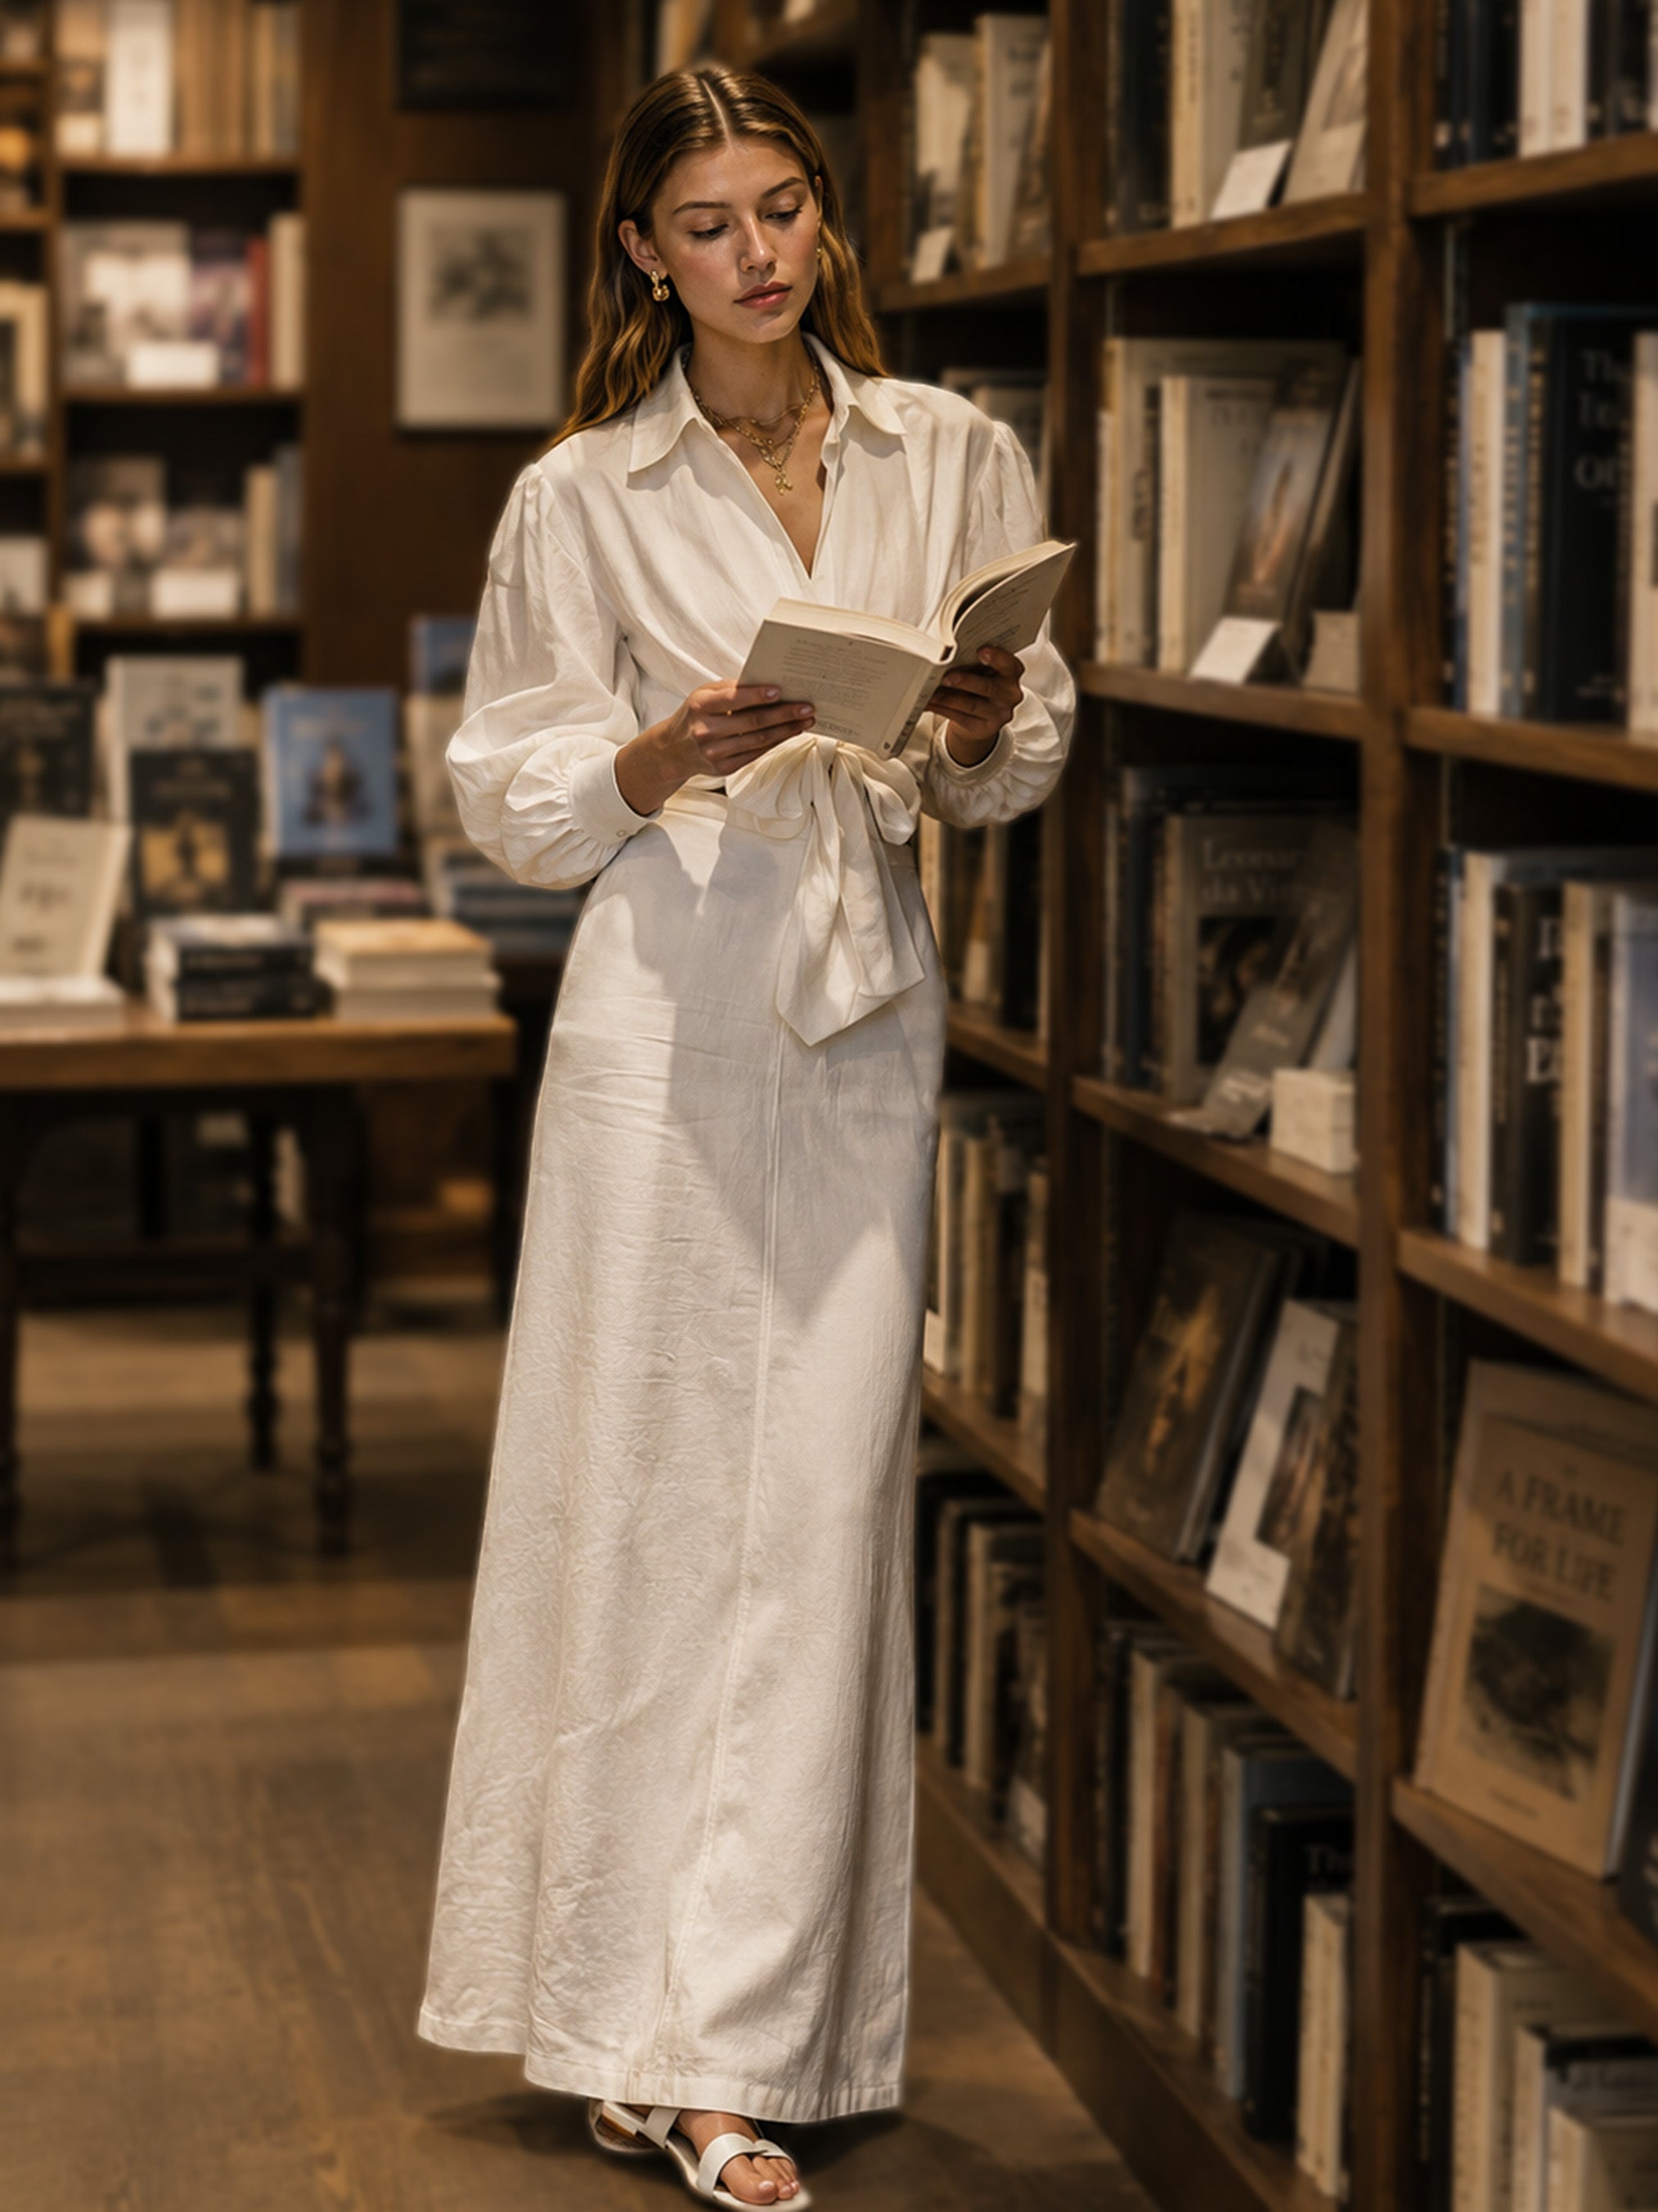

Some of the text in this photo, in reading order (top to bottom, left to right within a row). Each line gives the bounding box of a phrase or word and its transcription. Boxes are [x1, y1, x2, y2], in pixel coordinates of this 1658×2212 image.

[1494, 1470, 1627, 1547] A FRAME
[1492, 1522, 1617, 1602] FOR LIFE
